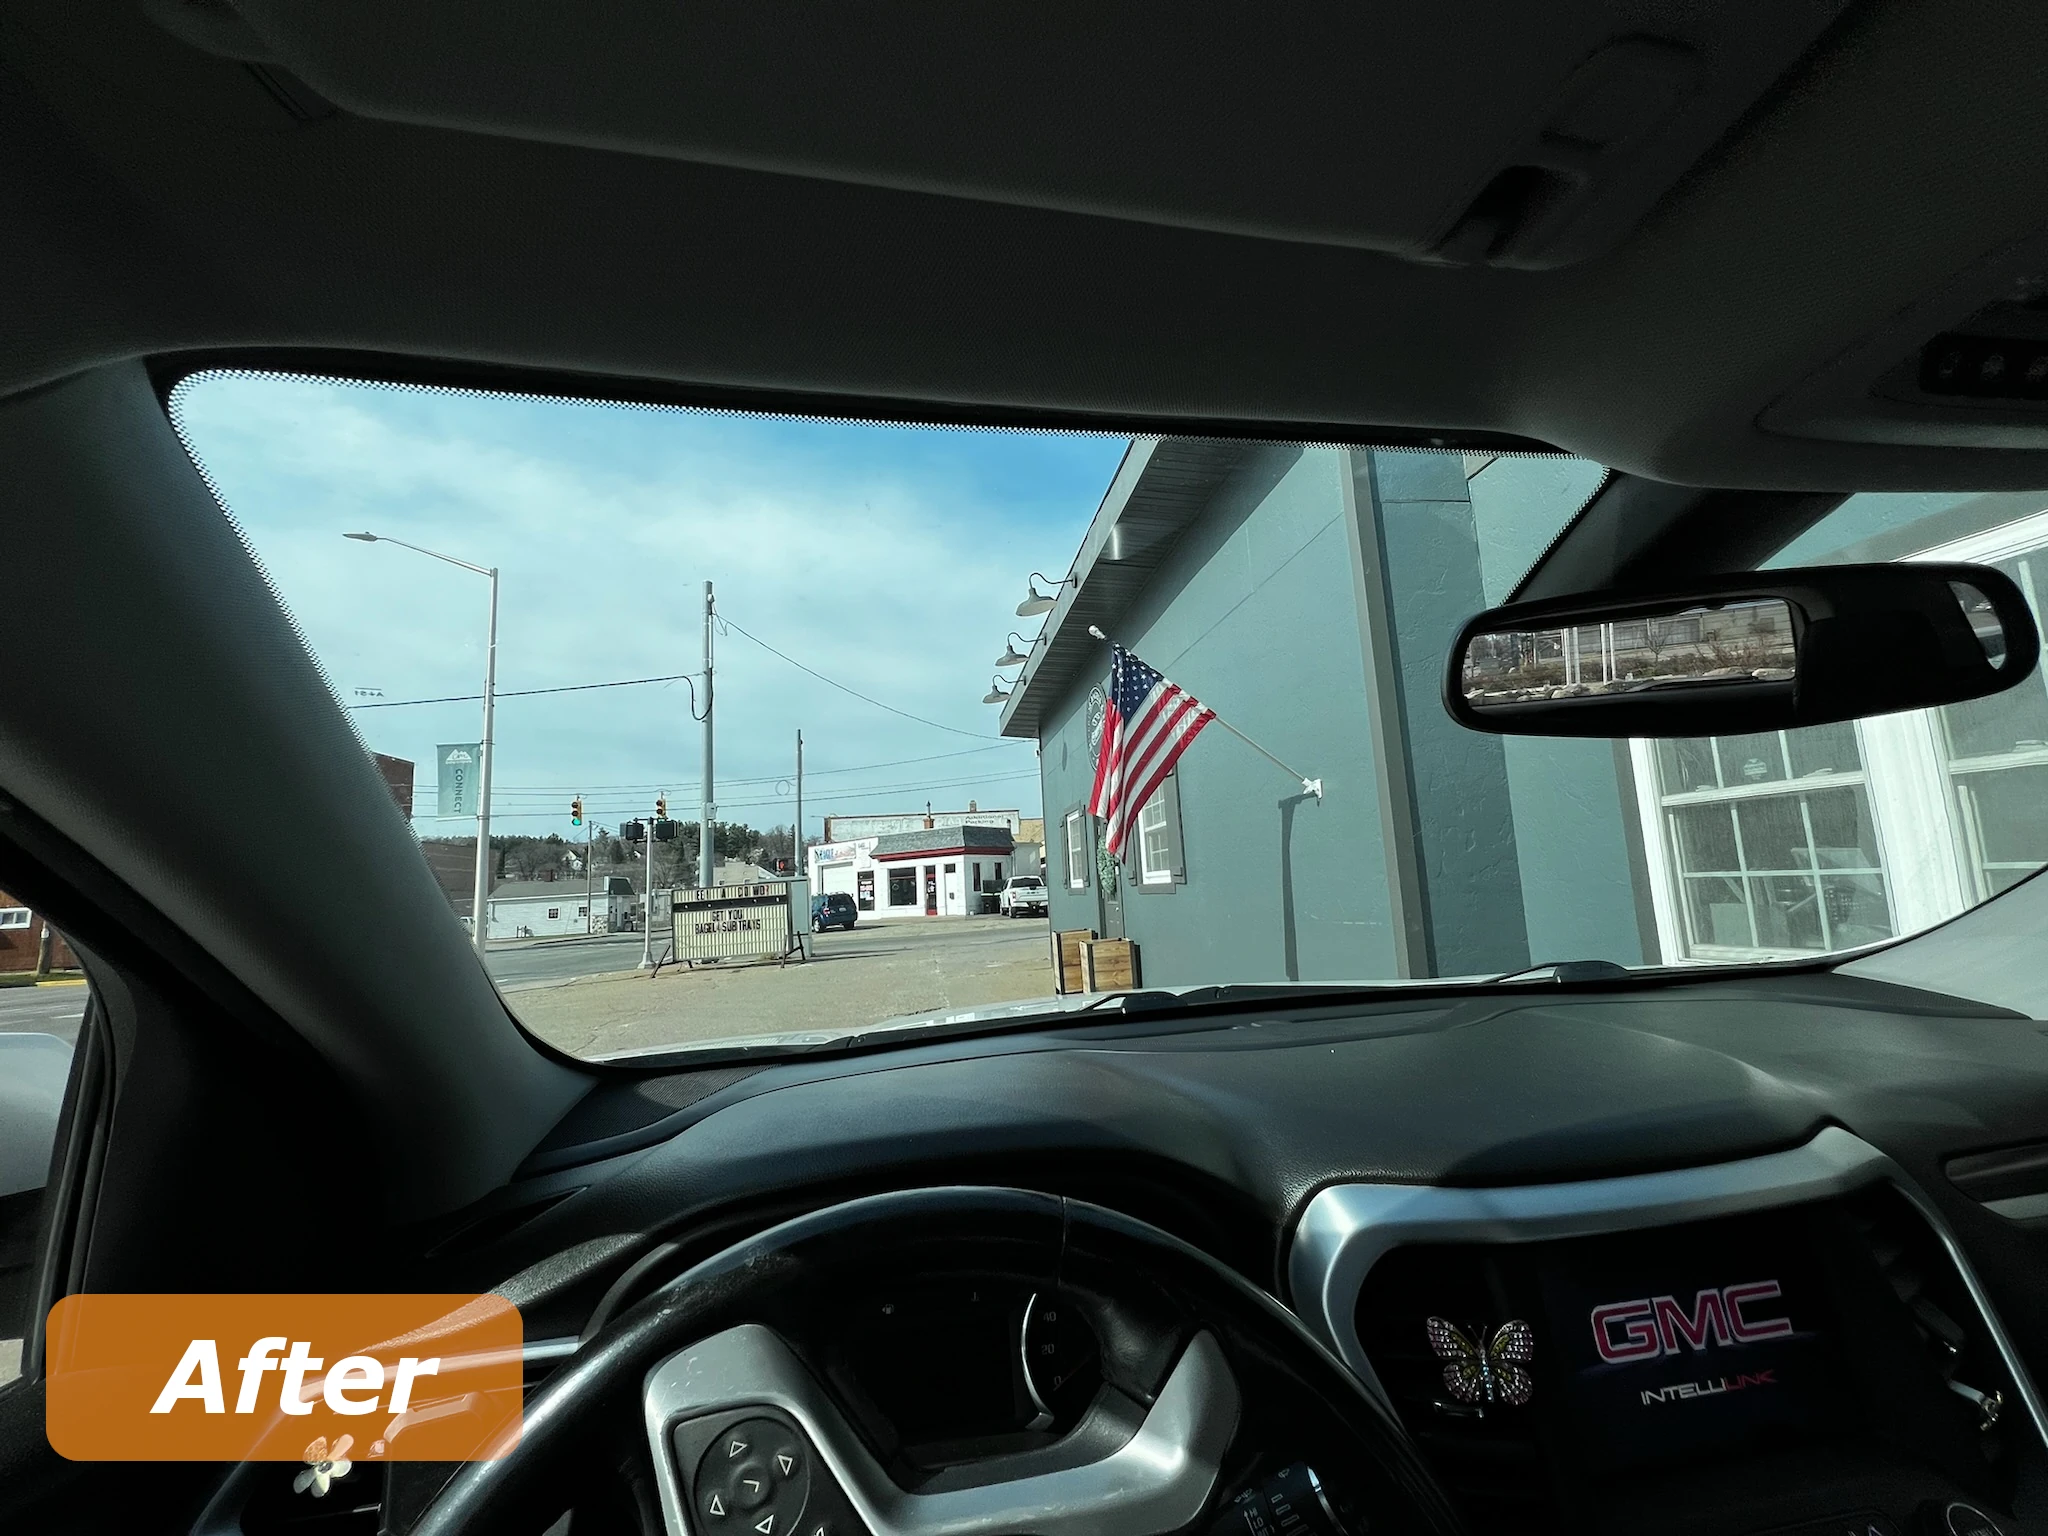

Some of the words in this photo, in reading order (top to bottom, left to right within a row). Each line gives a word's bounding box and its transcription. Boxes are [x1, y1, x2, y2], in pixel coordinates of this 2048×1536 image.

[453, 768, 463, 814] CONNECT
[695, 923, 716, 935] BAGEL
[722, 920, 737, 932] SUB
[738, 919, 761, 931] TRAYS
[1042, 1311, 1057, 1322] 40
[1591, 1279, 1794, 1365] GMC
[1041, 1343, 1055, 1355] 20
[1640, 1368, 1778, 1406] INTELLILINK
